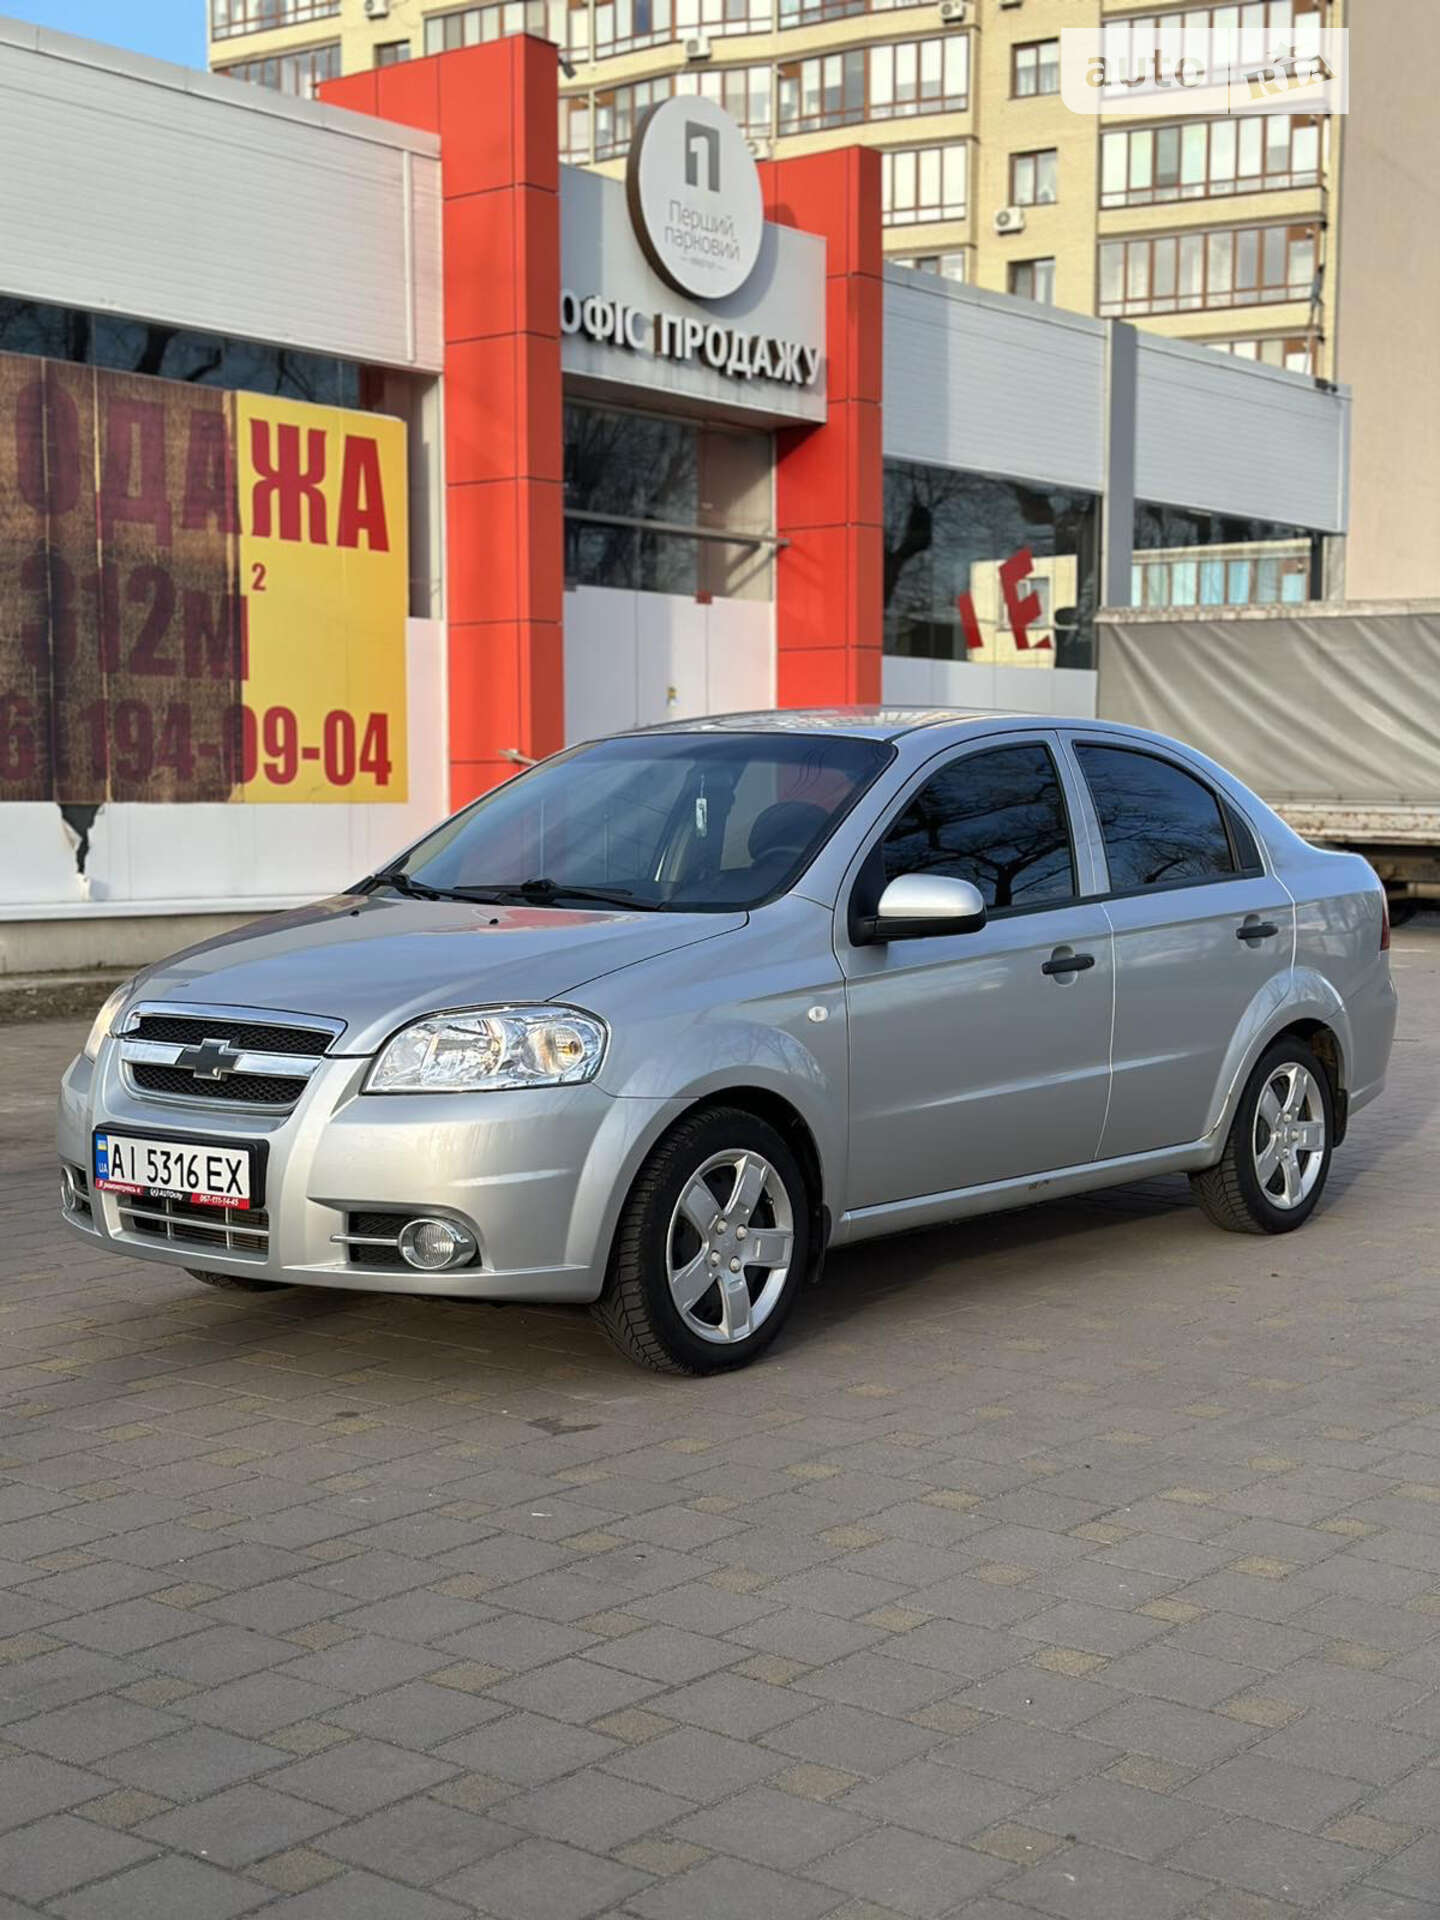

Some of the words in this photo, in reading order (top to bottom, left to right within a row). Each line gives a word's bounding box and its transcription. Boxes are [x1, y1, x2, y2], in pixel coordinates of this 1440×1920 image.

[668, 199, 735, 238] Перший
[561, 289, 646, 350] ОФІС
[660, 312, 821, 385] ПРОДАЖУ
[111, 1143, 135, 1180] AI
[147, 1148, 199, 1189] 5316
[206, 1156, 243, 1195] EX
